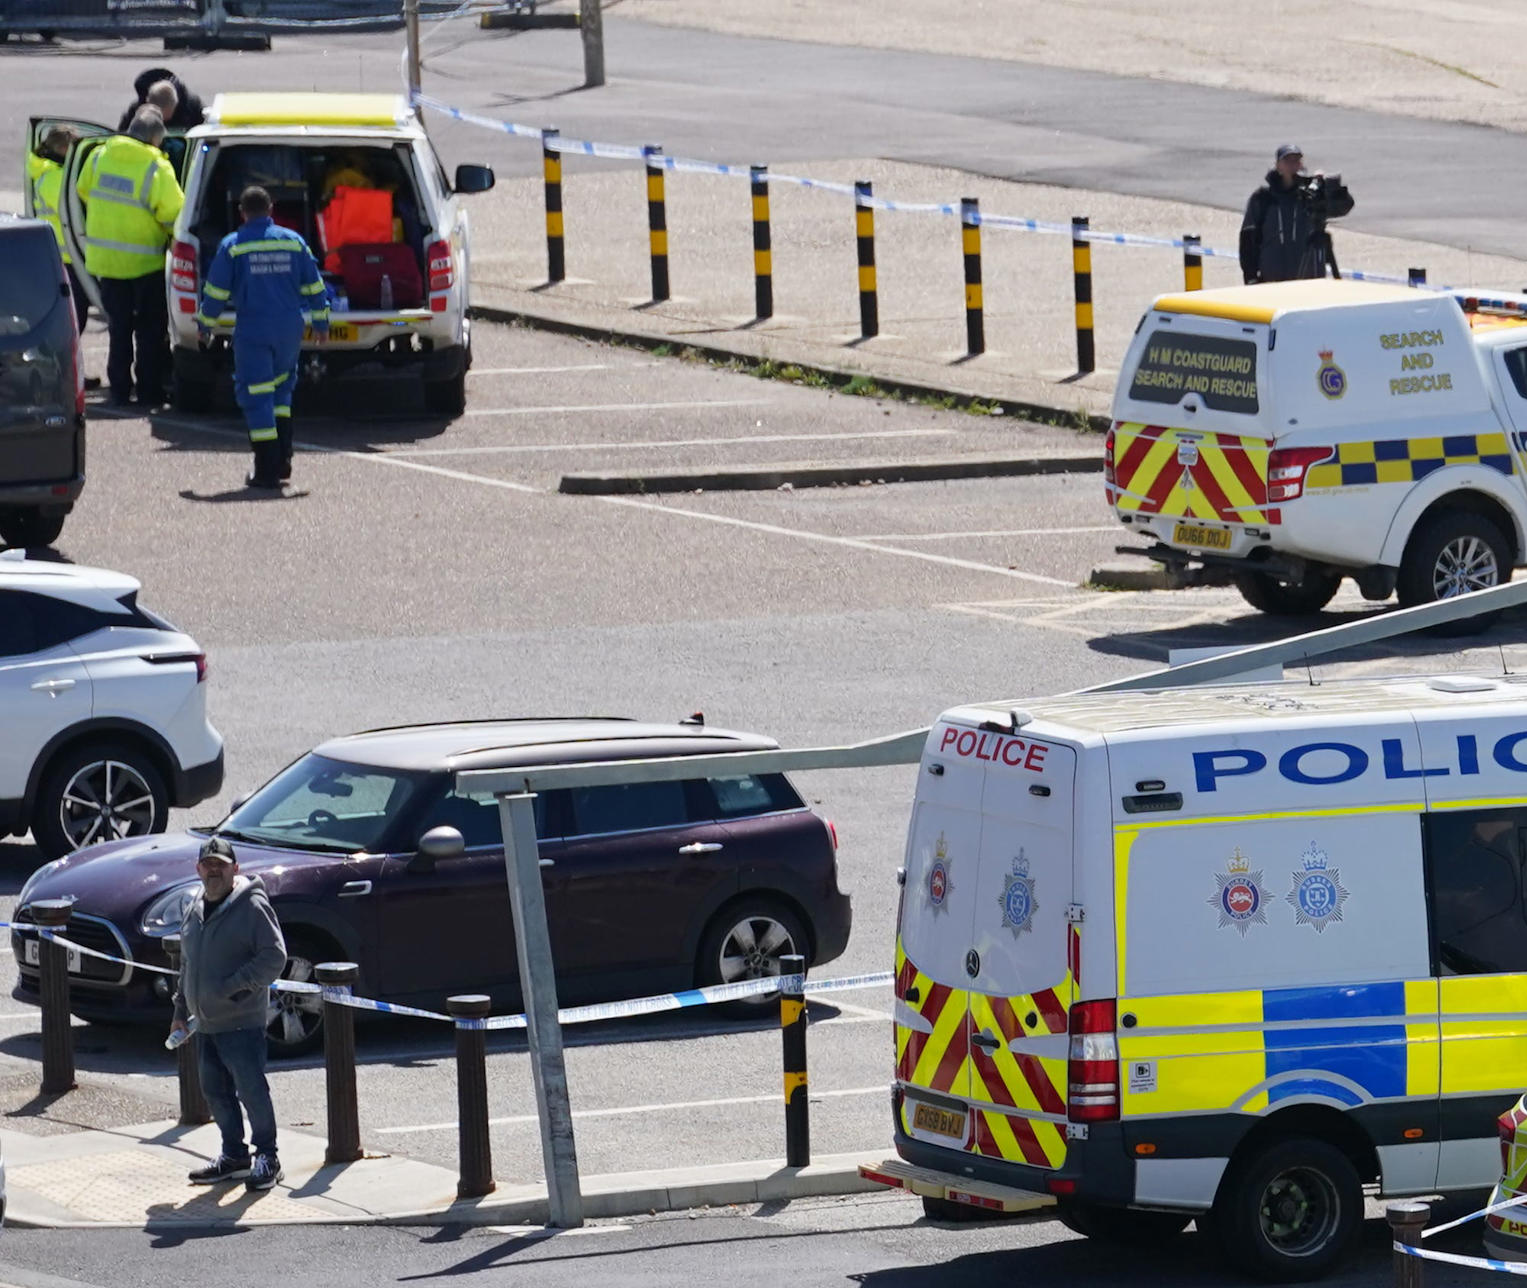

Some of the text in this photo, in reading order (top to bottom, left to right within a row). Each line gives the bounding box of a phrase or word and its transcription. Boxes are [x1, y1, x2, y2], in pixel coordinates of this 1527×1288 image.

[1379, 329, 1444, 350] SEARCH
[1149, 347, 1159, 363] H
[1173, 349, 1251, 373] COASTGUARD
[1401, 353, 1434, 371] AND
[1135, 369, 1256, 398] SEARCH AND RESCUE
[1389, 373, 1453, 395] RESCUE
[940, 727, 1049, 772] POLICE
